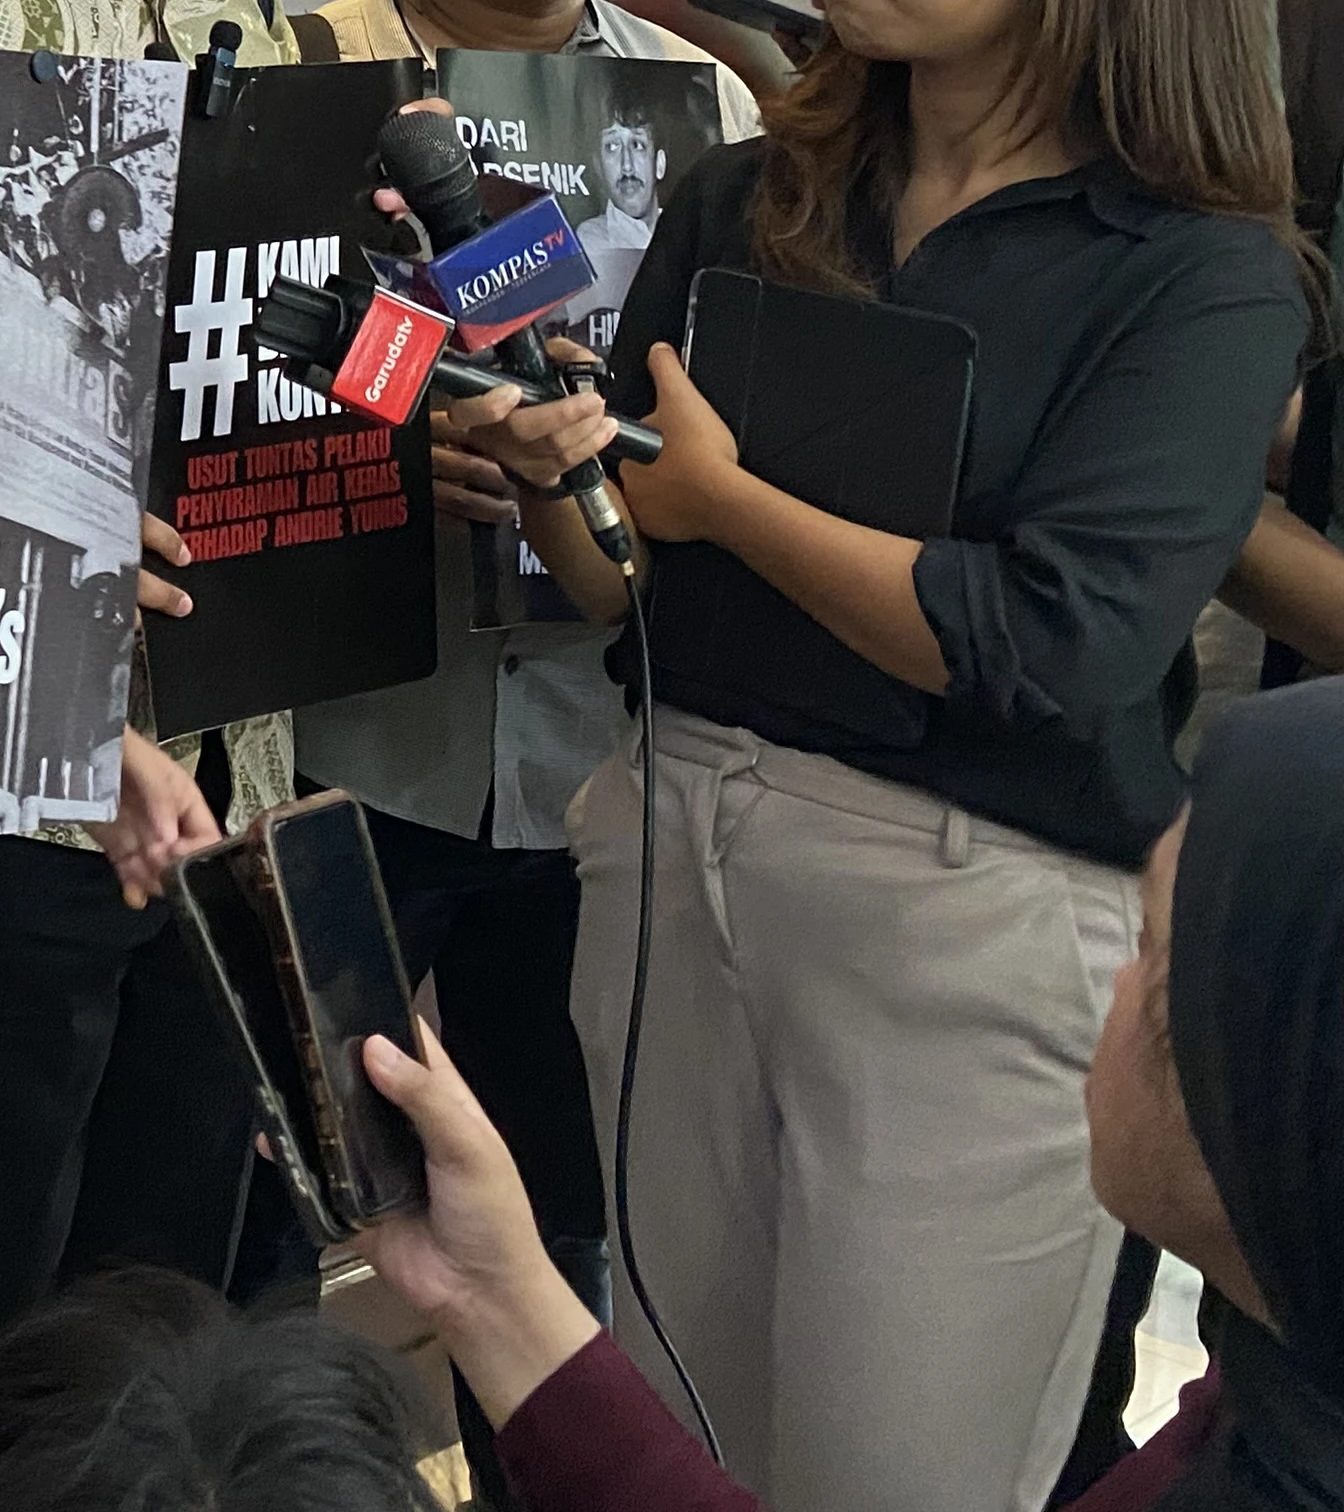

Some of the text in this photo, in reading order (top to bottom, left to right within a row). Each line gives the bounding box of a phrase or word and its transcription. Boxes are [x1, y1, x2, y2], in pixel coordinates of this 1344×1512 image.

[455, 116, 528, 152] DARI
[258, 235, 340, 299] KAMI
[456, 241, 548, 310] KOMPAS
[544, 228, 567, 251] TV
[187, 427, 392, 490] USUT TUNTAS PELAKU
[176, 478, 299, 529] PENYIRAMAN
[306, 471, 338, 506] AIR
[344, 460, 401, 501] KERAS
[274, 506, 344, 548] ANDRIE
[349, 494, 408, 535] YUNUS
